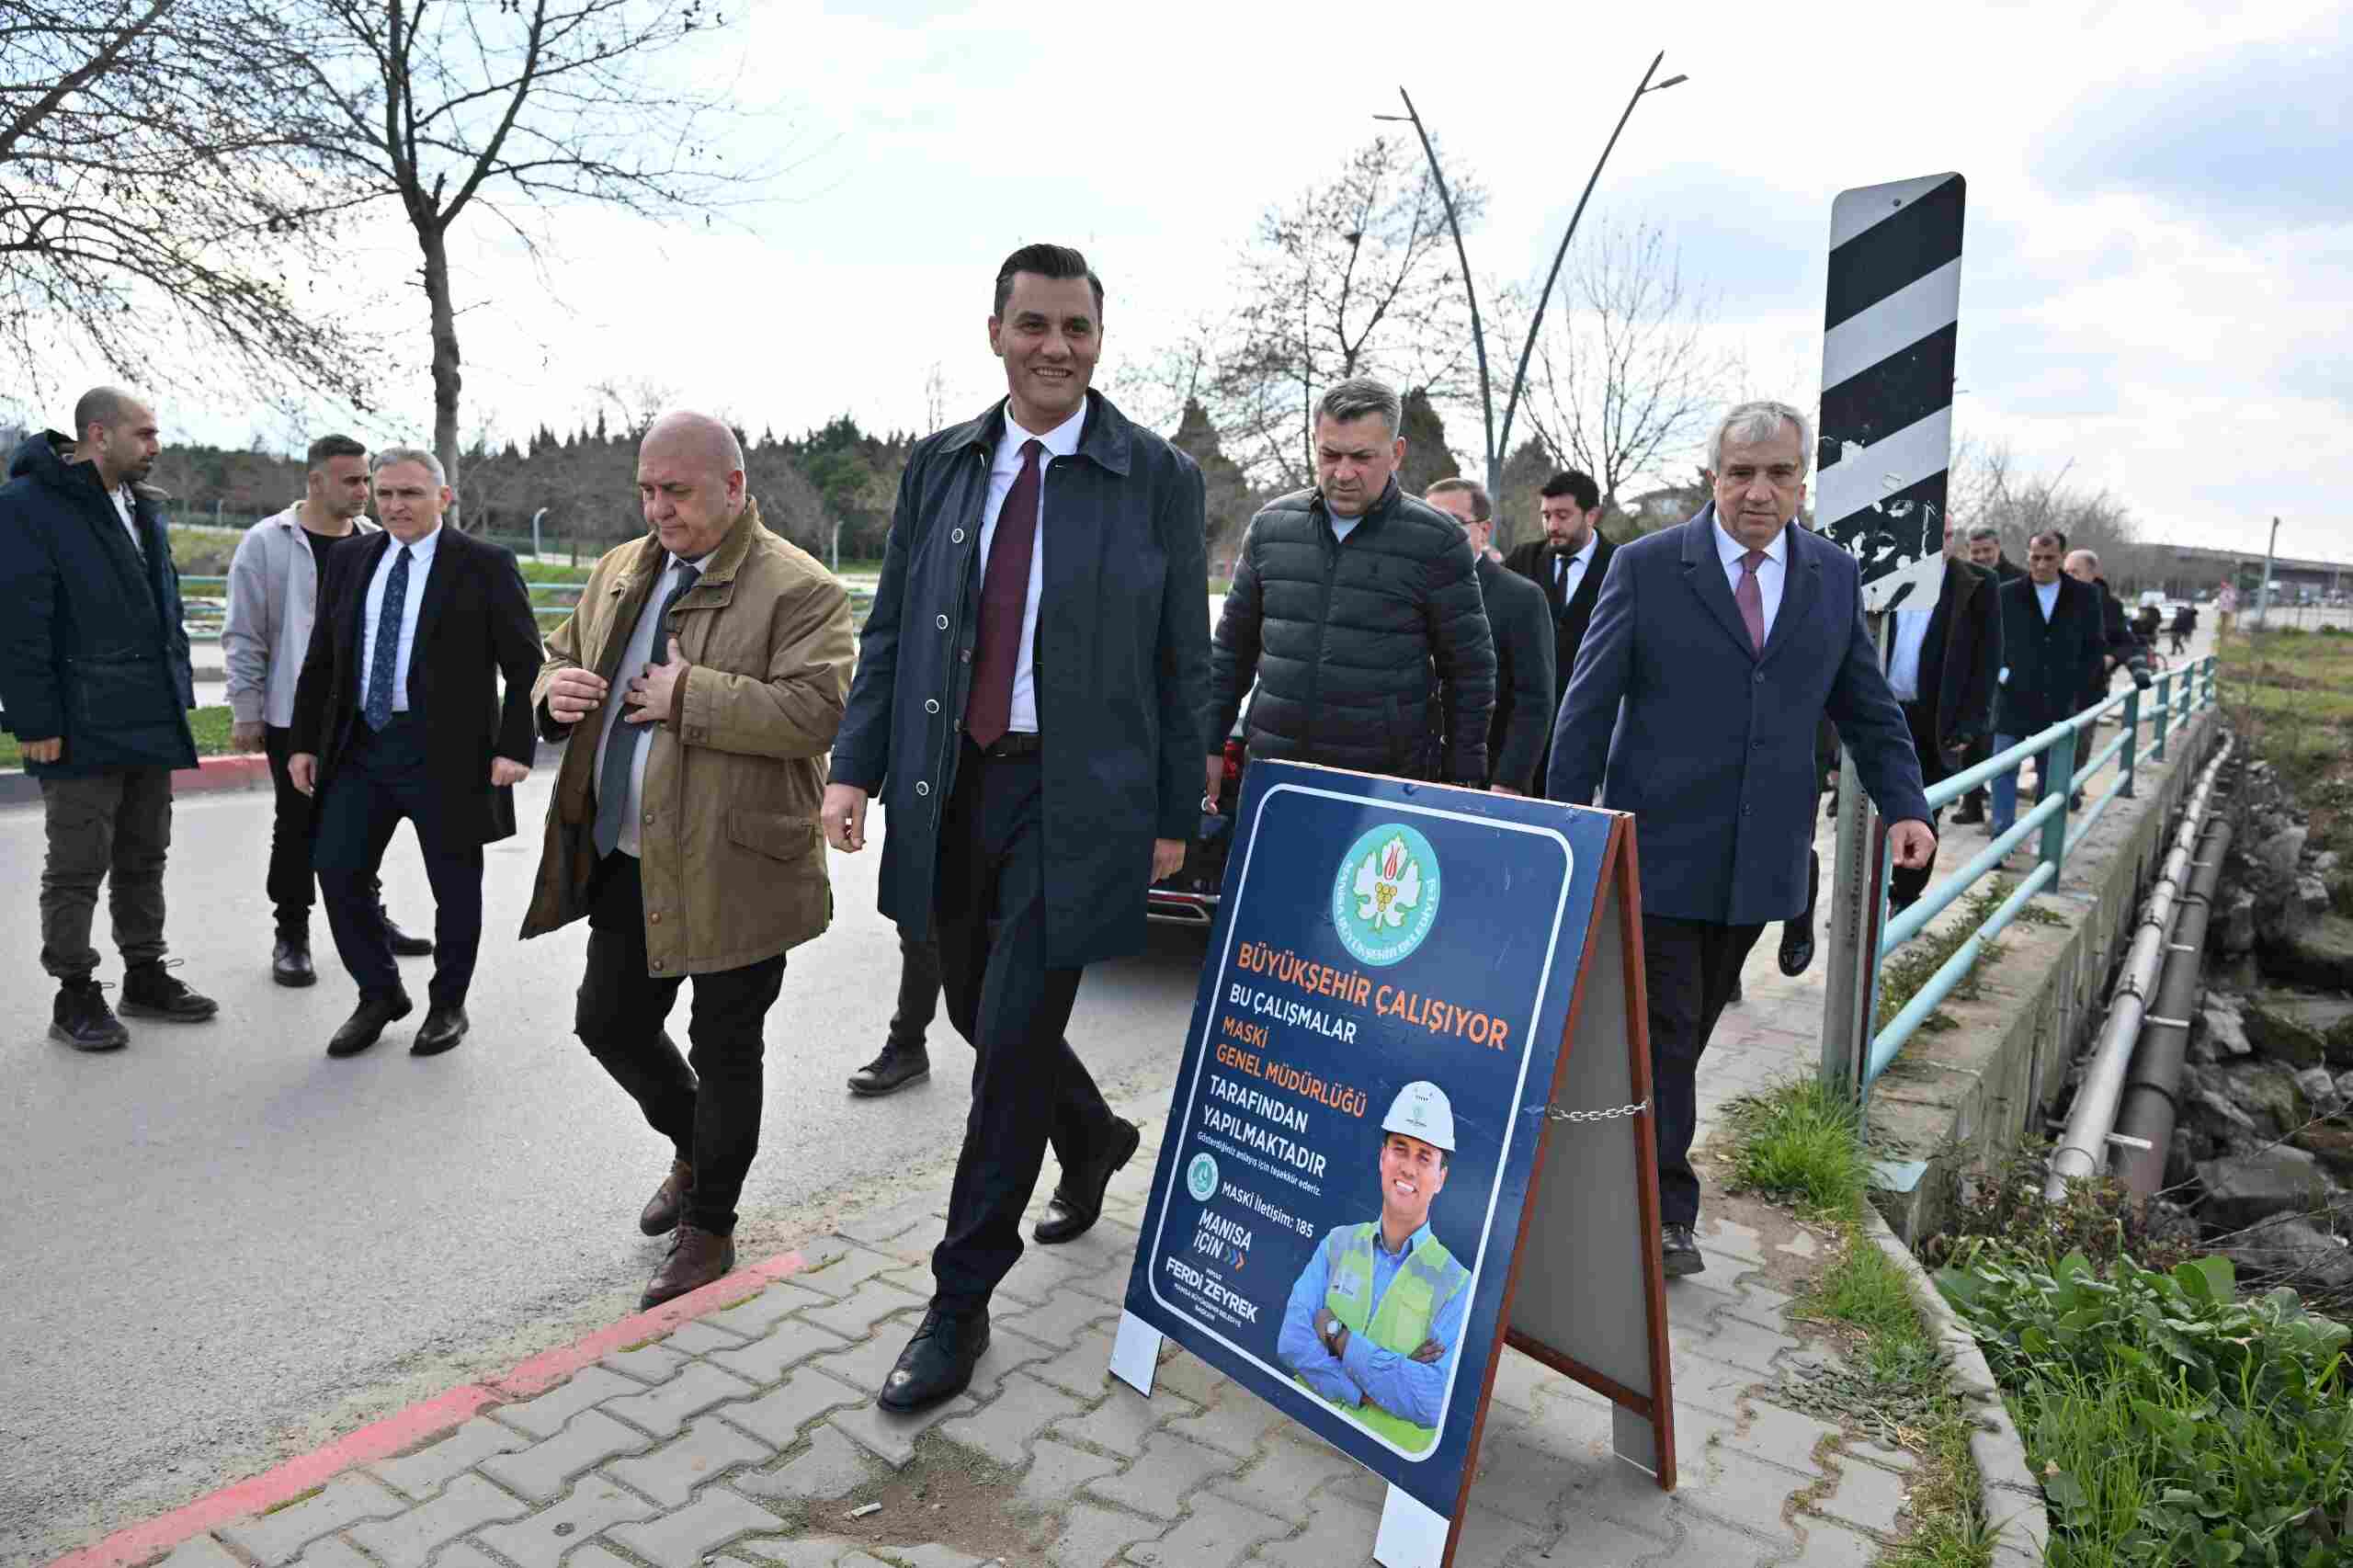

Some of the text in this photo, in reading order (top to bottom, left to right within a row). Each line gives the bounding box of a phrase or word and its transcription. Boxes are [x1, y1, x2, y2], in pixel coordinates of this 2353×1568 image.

[1229, 983, 1357, 1044] BU ÇALIŞMALAR
[1237, 941, 1508, 1051] BÜYÜKŞEHİR ÇALIŞIYOR
[1222, 1015, 1269, 1049] MASKİ
[1210, 1074, 1308, 1133] TARAFINDAN
[1216, 1043, 1368, 1118] GENEL MÜDÜRLÜĞÜ
[1203, 1105, 1326, 1177] YAPILMAKTADIR
[1199, 1209, 1252, 1251] MANİSA
[1221, 1182, 1313, 1238] MASKİ İletişim: 185
[1193, 1230, 1224, 1258] İÇİN
[1165, 1256, 1203, 1290] FERDİ
[1205, 1279, 1258, 1324] ZEYREK
